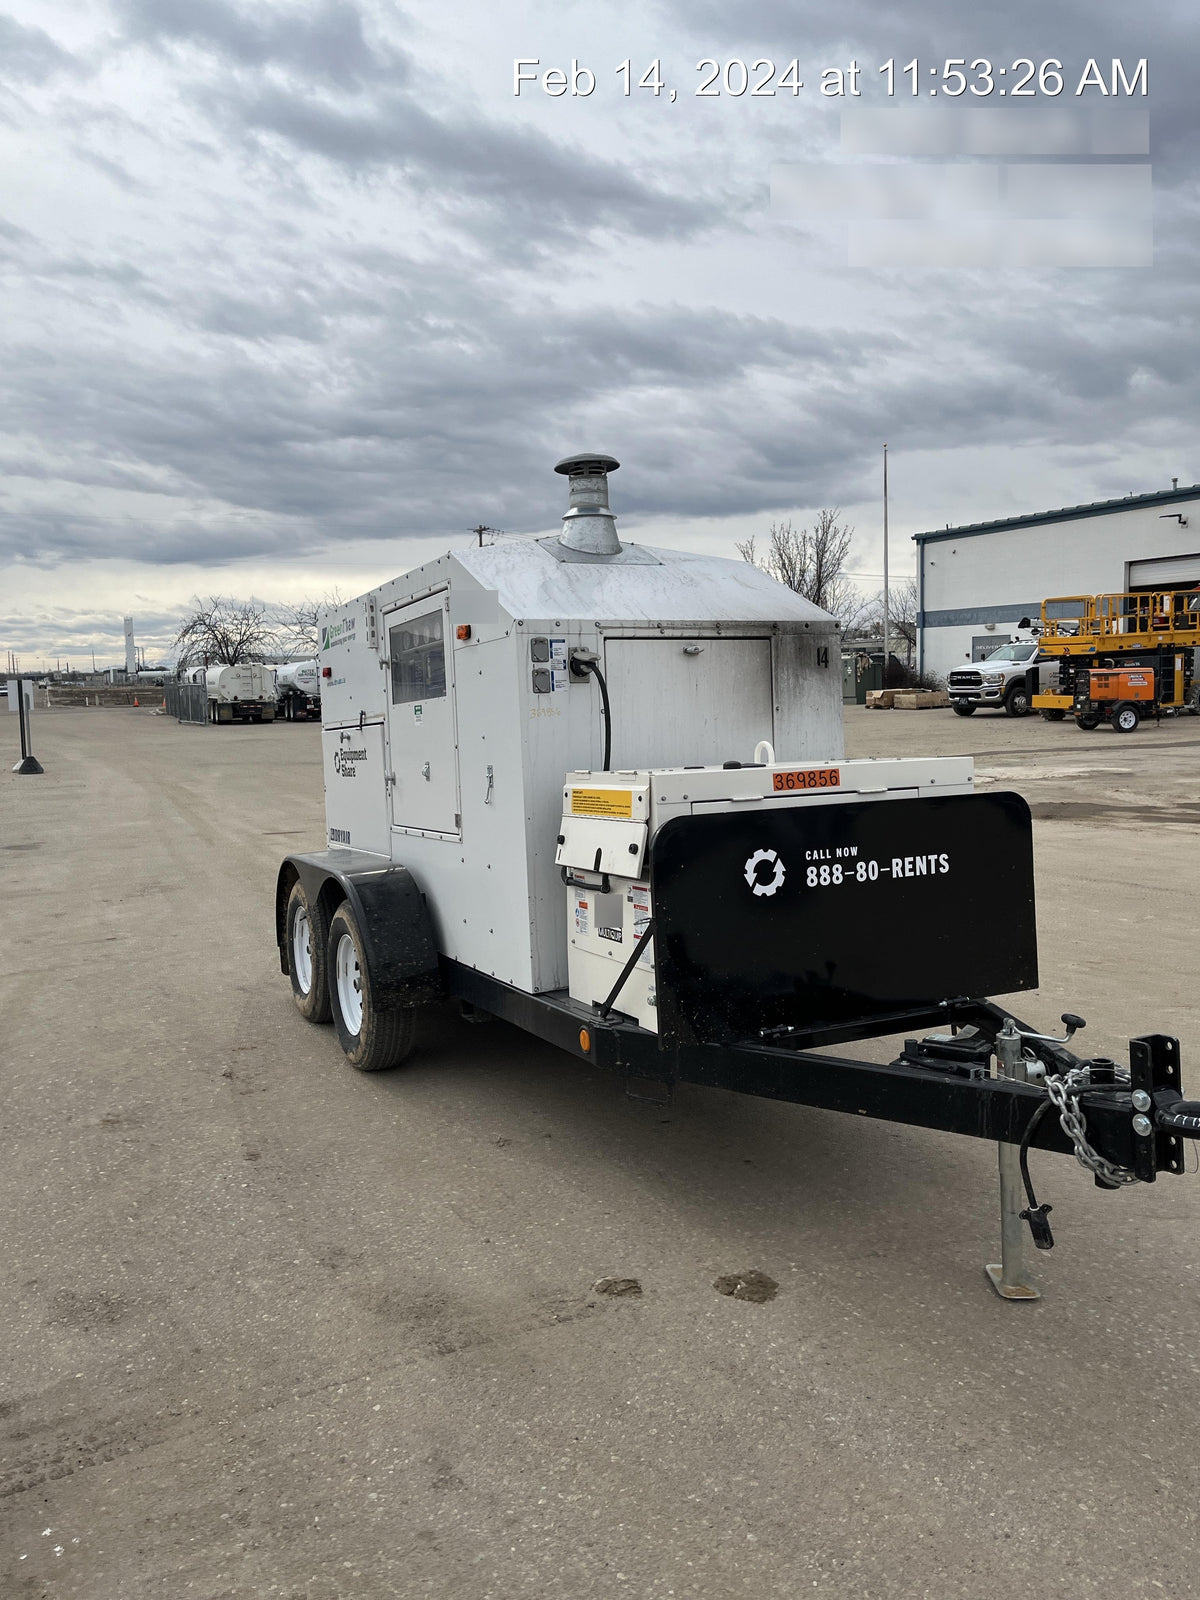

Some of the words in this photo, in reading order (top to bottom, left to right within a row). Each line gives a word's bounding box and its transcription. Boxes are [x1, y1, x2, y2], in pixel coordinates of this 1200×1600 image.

[816, 646, 830, 669] 14
[340, 748, 367, 763] Equipment
[341, 764, 356, 777] Share
[775, 770, 839, 791] 369856
[805, 850, 832, 861] CALL
[836, 846, 858, 858] NOW
[806, 853, 950, 887] 888-80-RENTS
